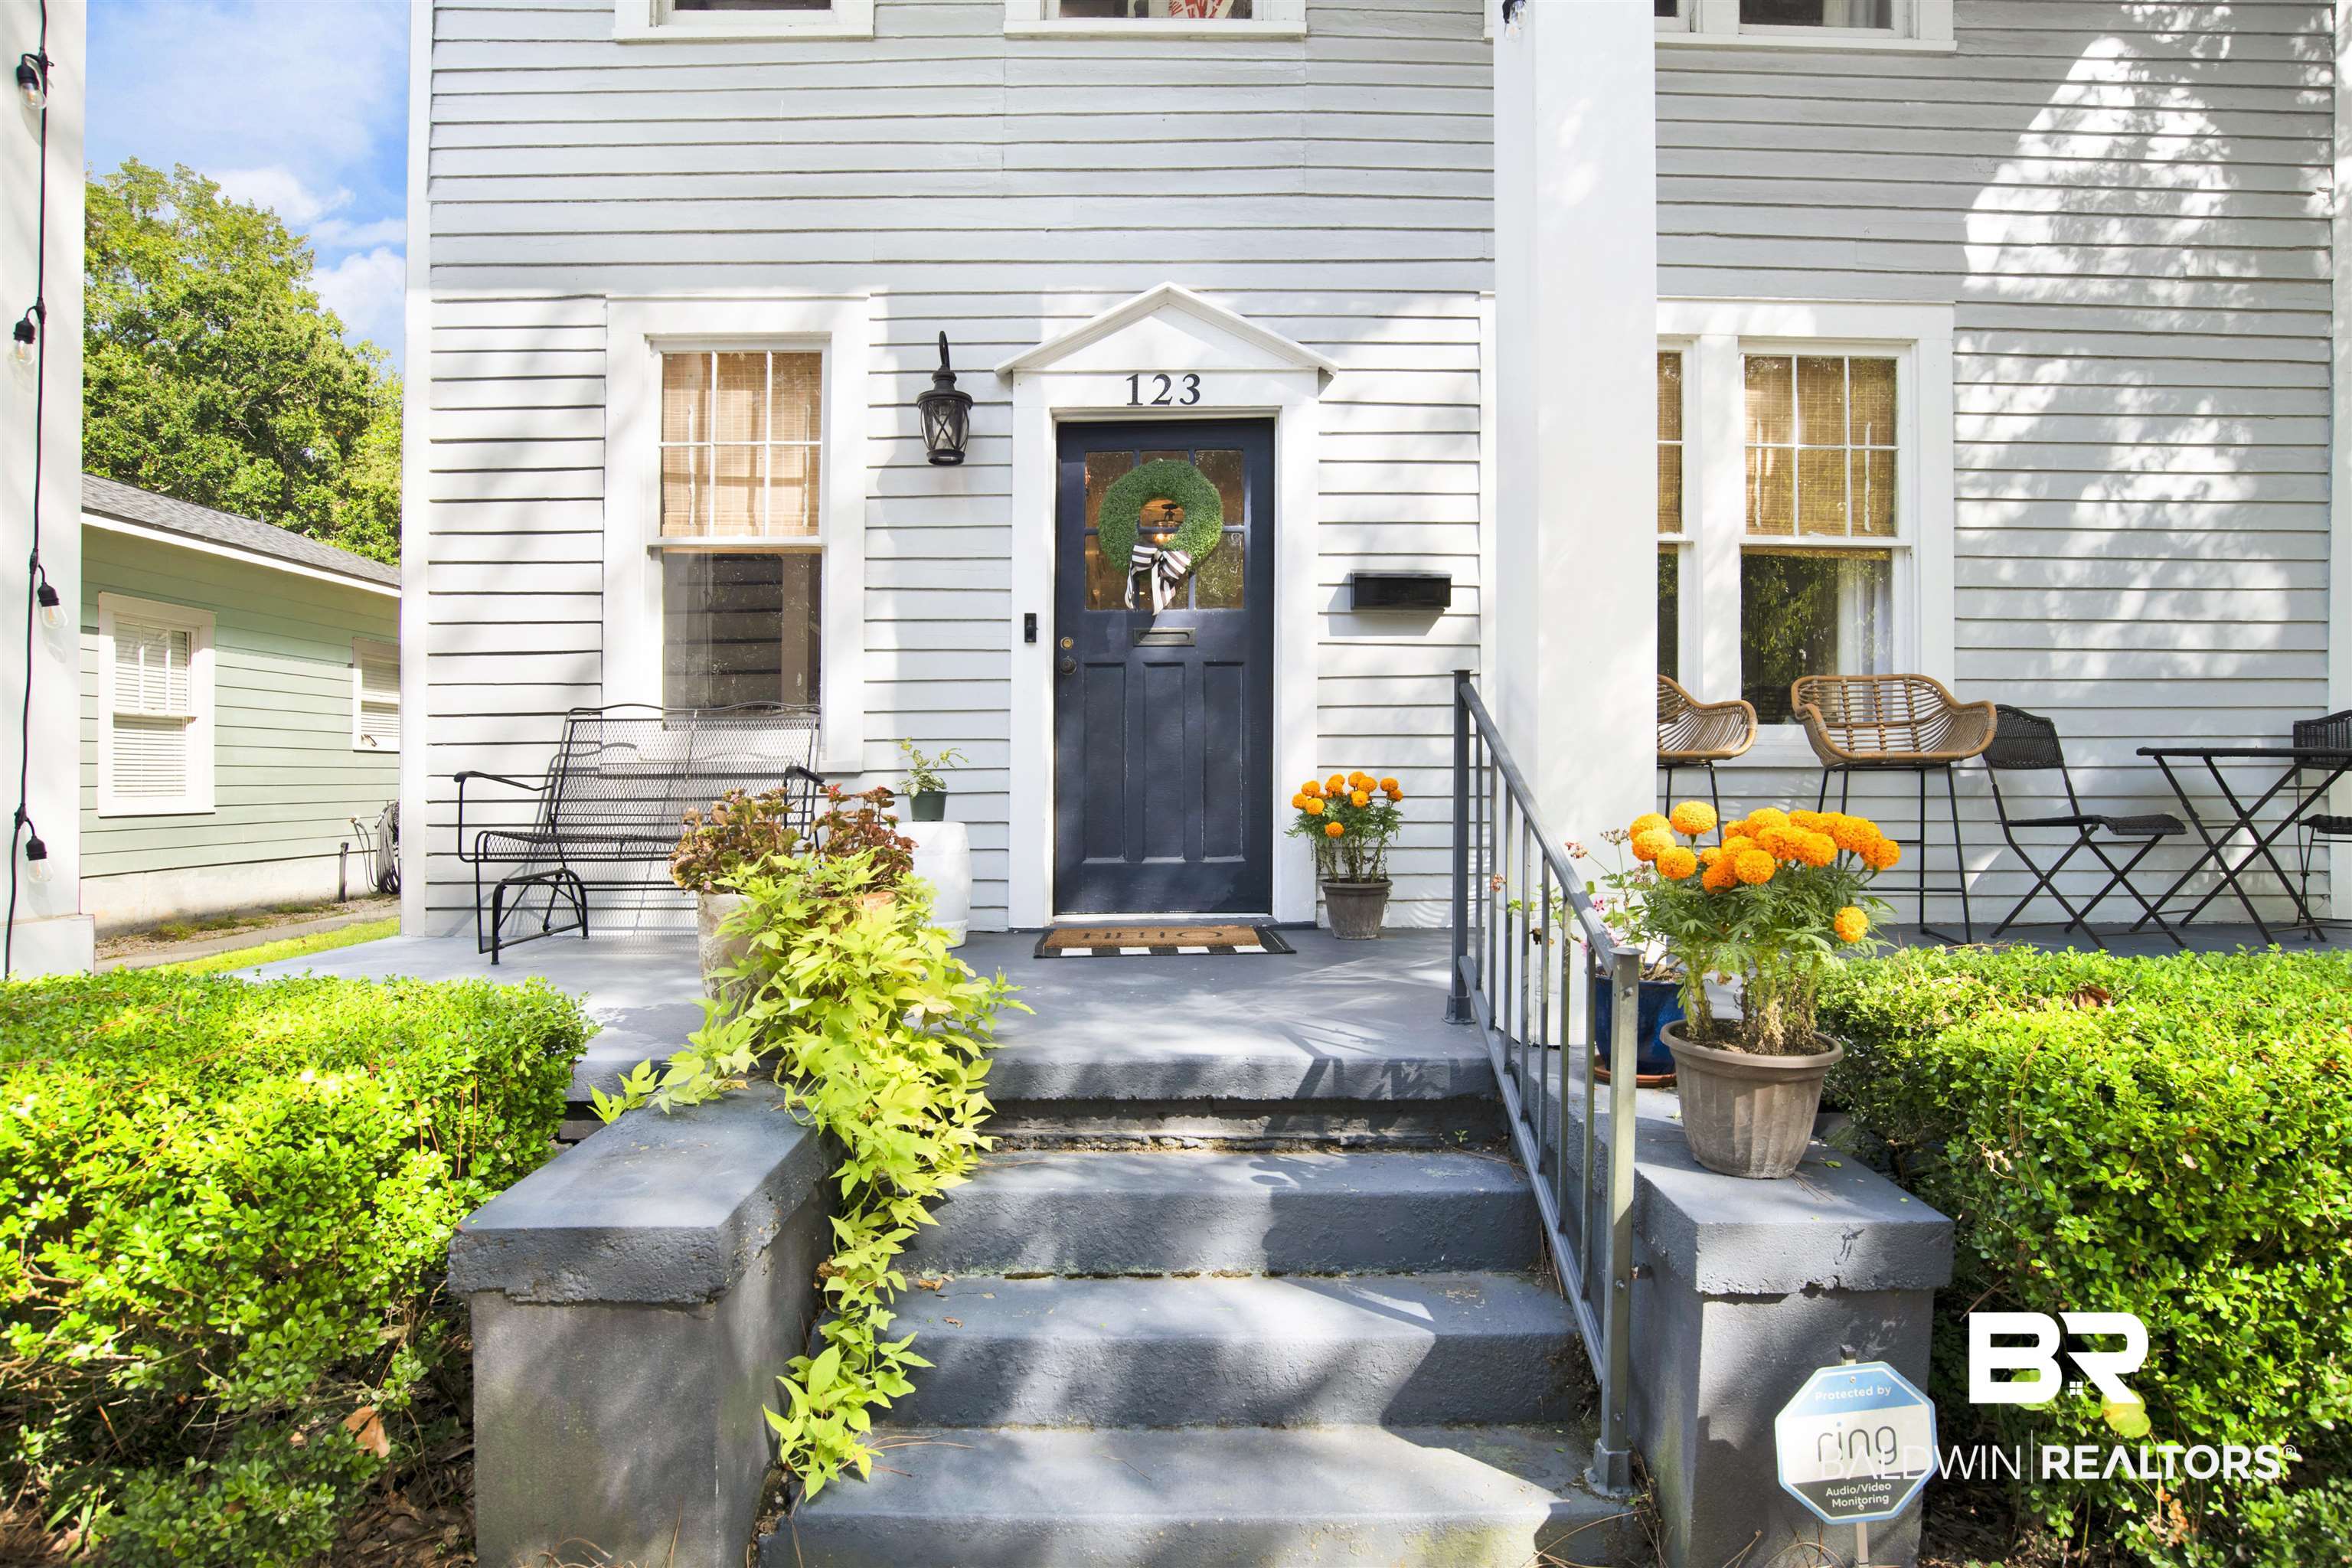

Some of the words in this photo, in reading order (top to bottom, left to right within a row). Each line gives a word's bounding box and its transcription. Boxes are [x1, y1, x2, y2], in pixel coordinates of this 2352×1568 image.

[1125, 373, 1200, 406] 123
[1815, 1386, 1873, 1401] Protected
[1877, 1385, 1891, 1396] by
[1818, 1421, 1897, 1465] ring
[1825, 1482, 1892, 1497] Audio/Video
[1831, 1494, 1890, 1508] Monitoring
